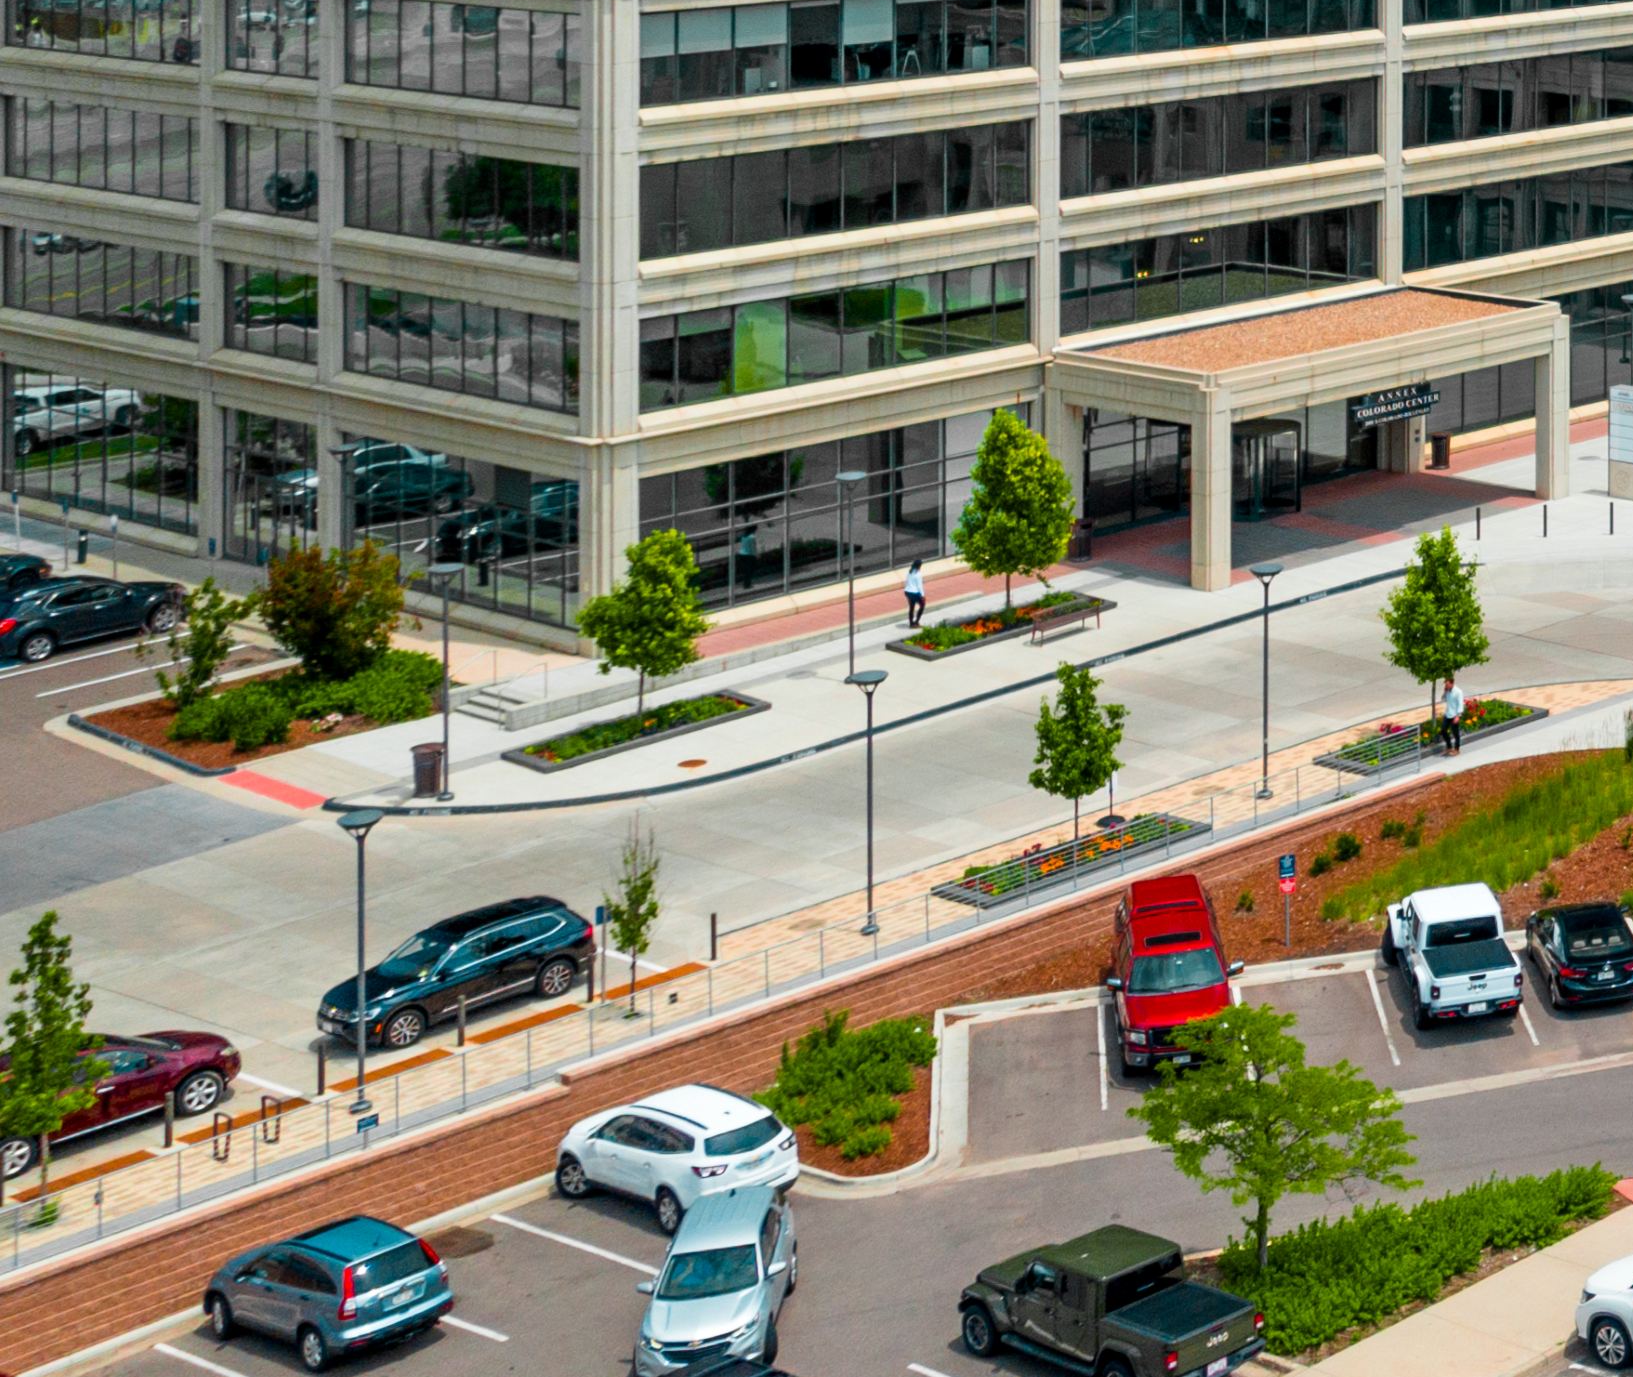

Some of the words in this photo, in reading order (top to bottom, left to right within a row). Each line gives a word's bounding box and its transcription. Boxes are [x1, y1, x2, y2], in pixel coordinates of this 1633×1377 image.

[1378, 386, 1417, 403] ANNEX
[1357, 402, 1404, 418] COLORADO
[1405, 393, 1439, 408] CENTER
